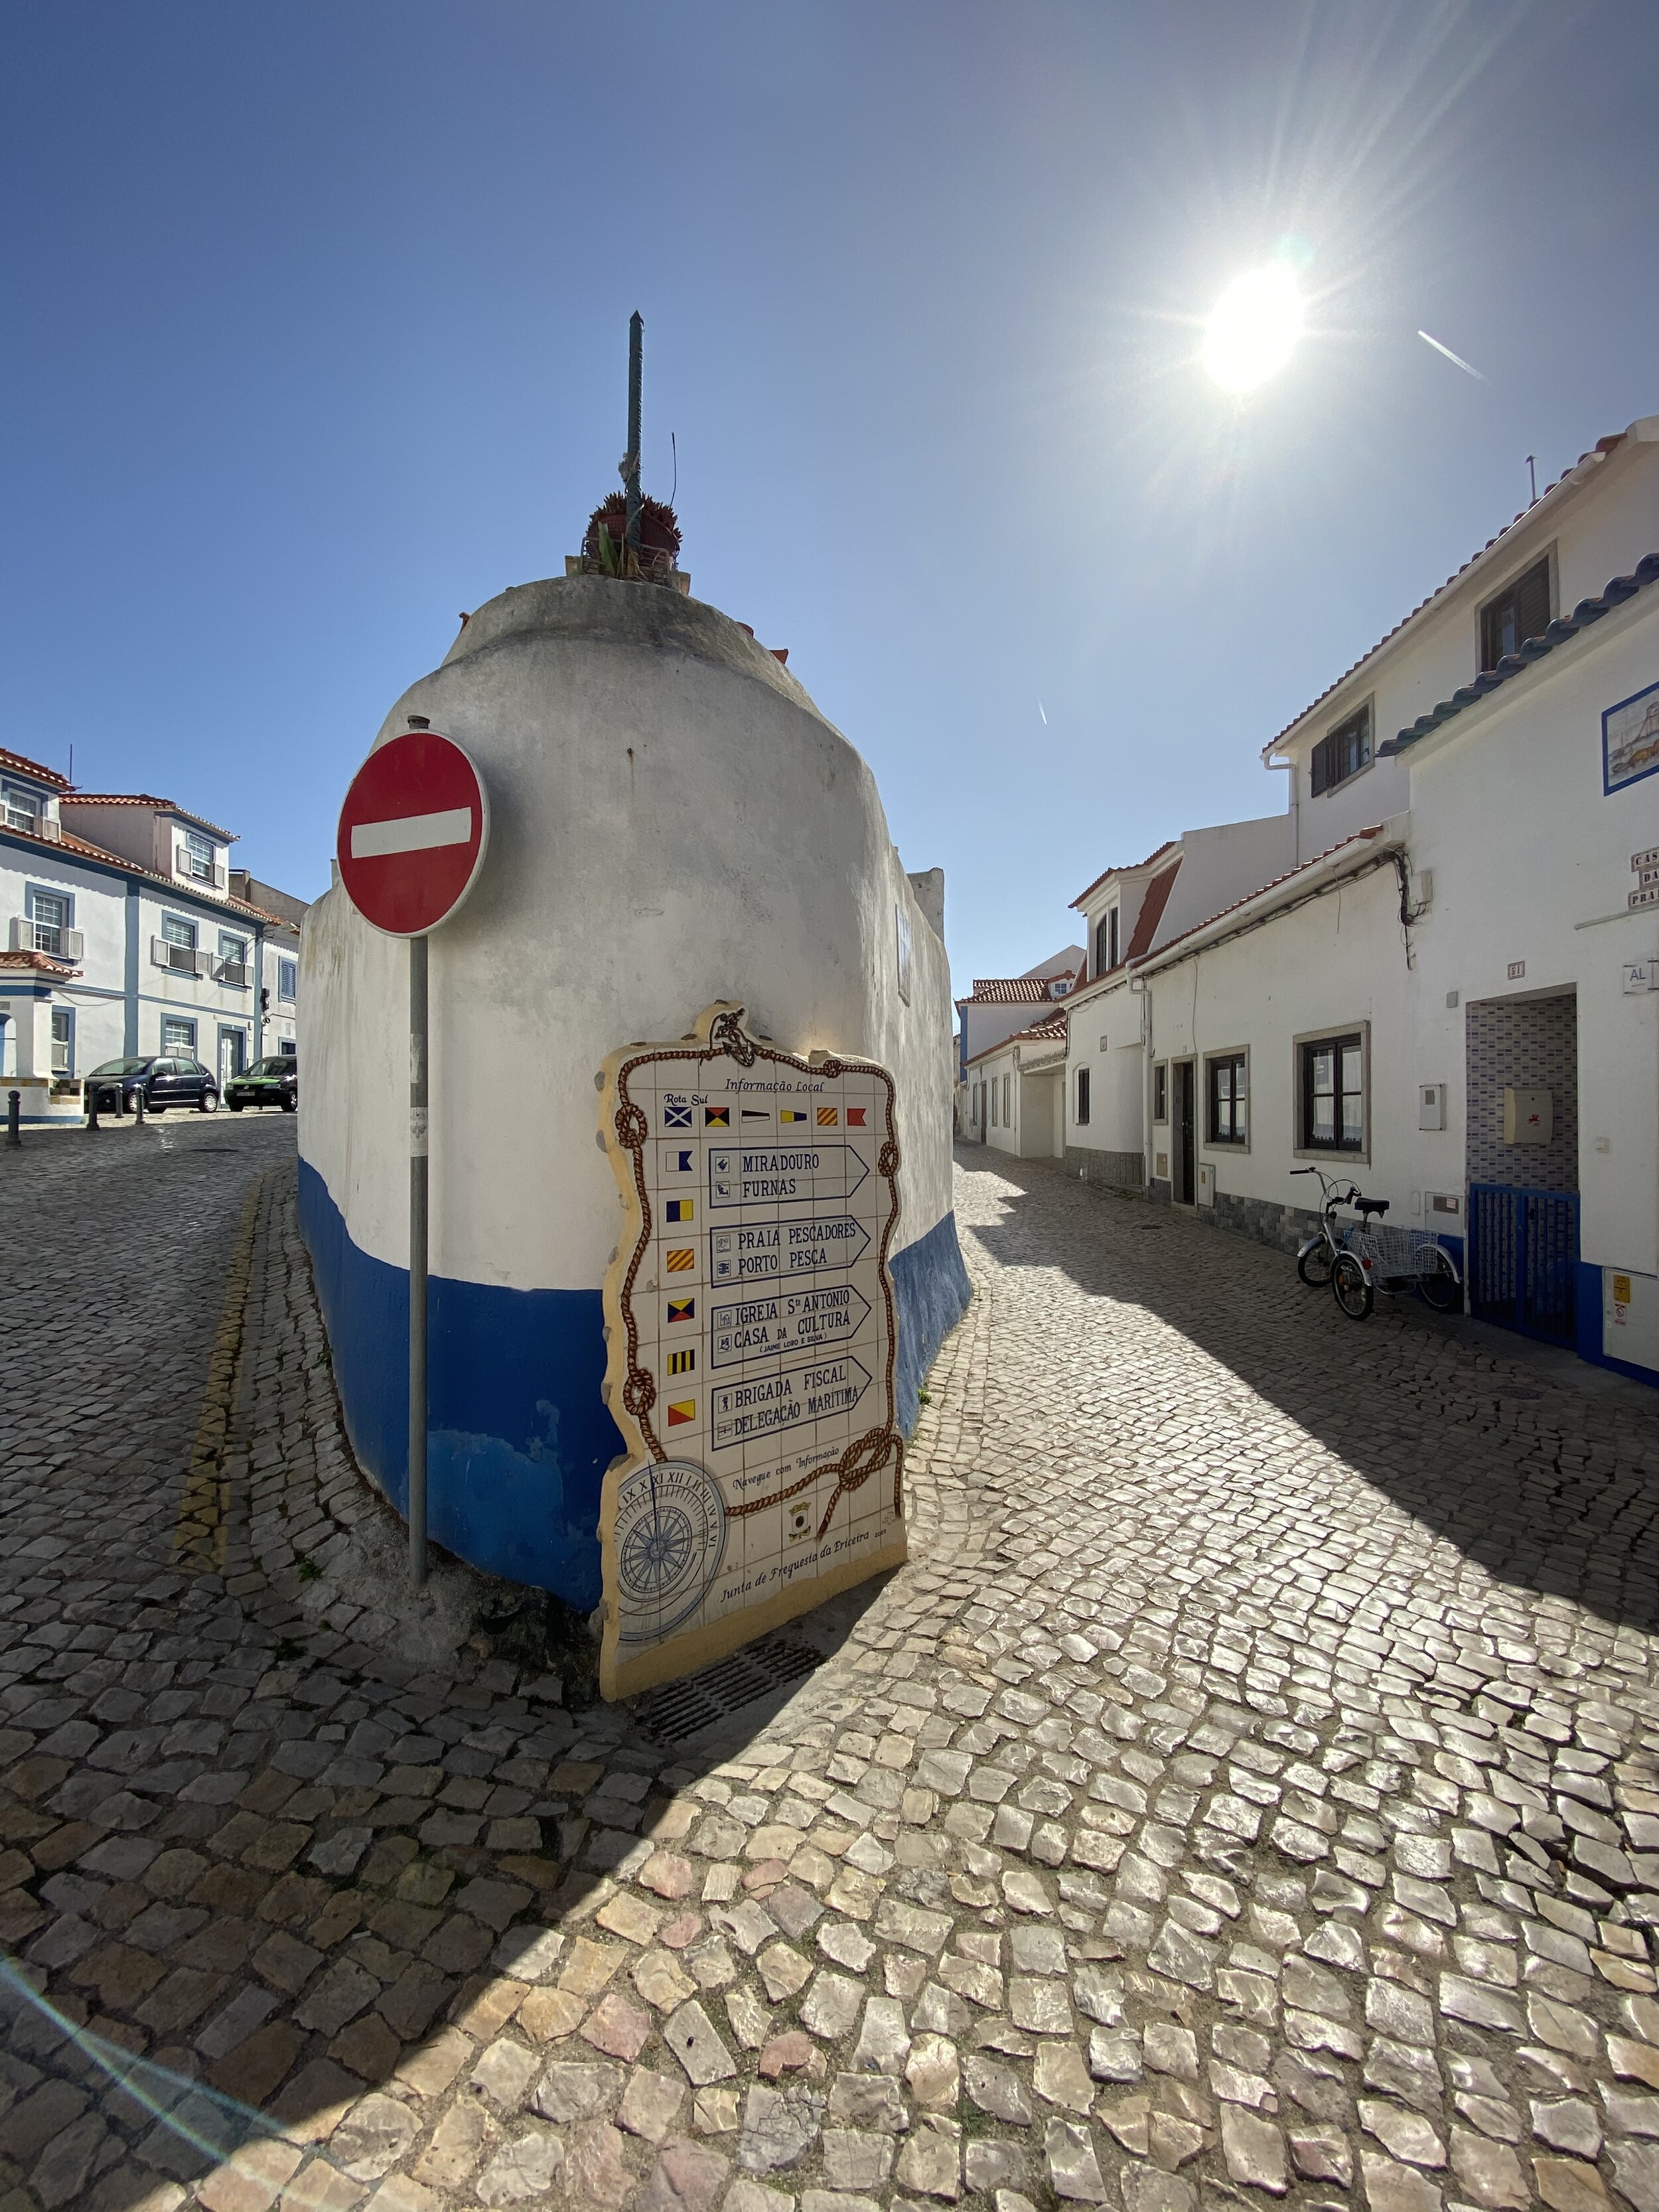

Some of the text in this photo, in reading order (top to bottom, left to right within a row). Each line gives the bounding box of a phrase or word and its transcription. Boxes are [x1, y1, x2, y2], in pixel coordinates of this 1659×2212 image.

[1630, 968, 1646, 982] AL
[725, 1078, 825, 1094] Informação Local
[664, 1093, 709, 1106] Rota Sul
[742, 1153, 820, 1173] MIRADOURO
[743, 1177, 796, 1198] FURNAS
[738, 1222, 857, 1250] PRAIA PESCADORES
[738, 1248, 828, 1275] PORTO PESCA
[735, 1302, 778, 1326] IGREJA
[802, 1290, 849, 1313] ANTÓNIO
[734, 1309, 851, 1349] CASA DA CULTURA
[783, 1339, 799, 1348] LOBO
[735, 1365, 847, 1408] BRIGADA FISCAL
[734, 1386, 858, 1436] DELEGAÇÃO MARÍTIMA
[668, 1471, 685, 1483] XII
[733, 1446, 839, 1491] Navegue com Informação
[639, 1479, 648, 1493] X
[652, 1473, 664, 1485] XI
[685, 1475, 692, 1486] I
[707, 1504, 717, 1516] IV
[709, 1534, 717, 1548] VI
[720, 1582, 752, 1603] Junta
[755, 1572, 766, 1587] de
[768, 1552, 818, 1581] Freguesia
[820, 1544, 831, 1560] da
[833, 1529, 869, 1554] Ericeira
